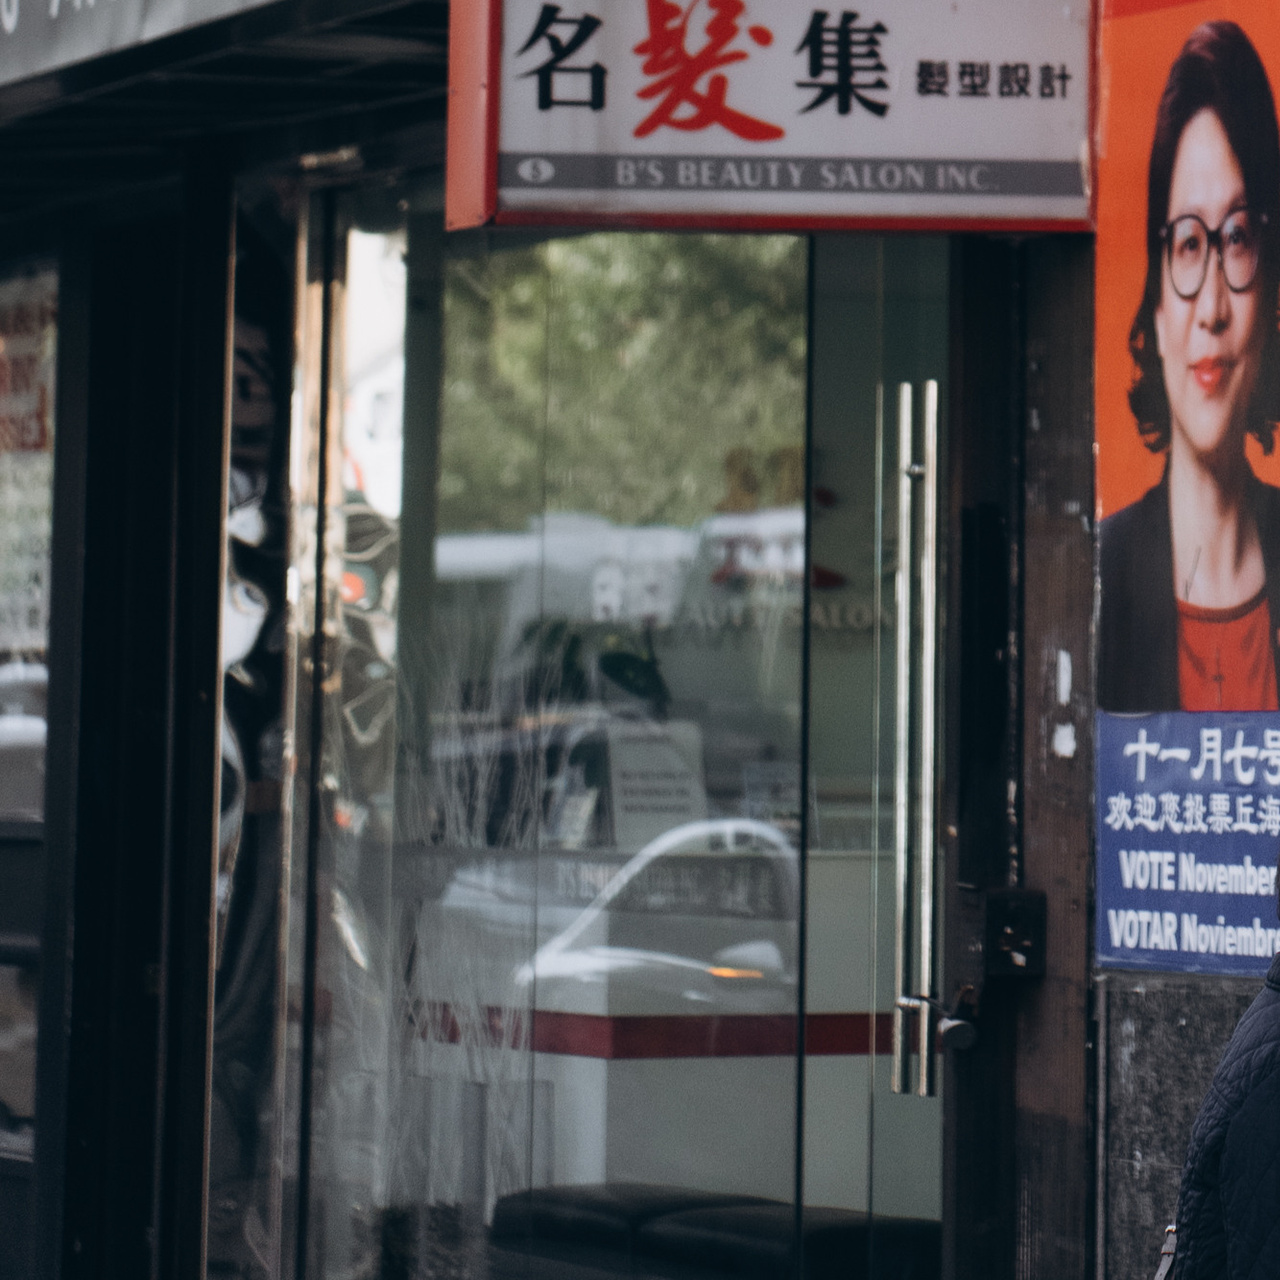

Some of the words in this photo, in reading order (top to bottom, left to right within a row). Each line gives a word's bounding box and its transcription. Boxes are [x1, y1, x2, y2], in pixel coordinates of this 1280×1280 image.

[677, 160, 806, 188] BEAUTY
[819, 163, 925, 190] SALON
[1118, 850, 1176, 890] VOTE
[1107, 909, 1178, 951] VOTAR
